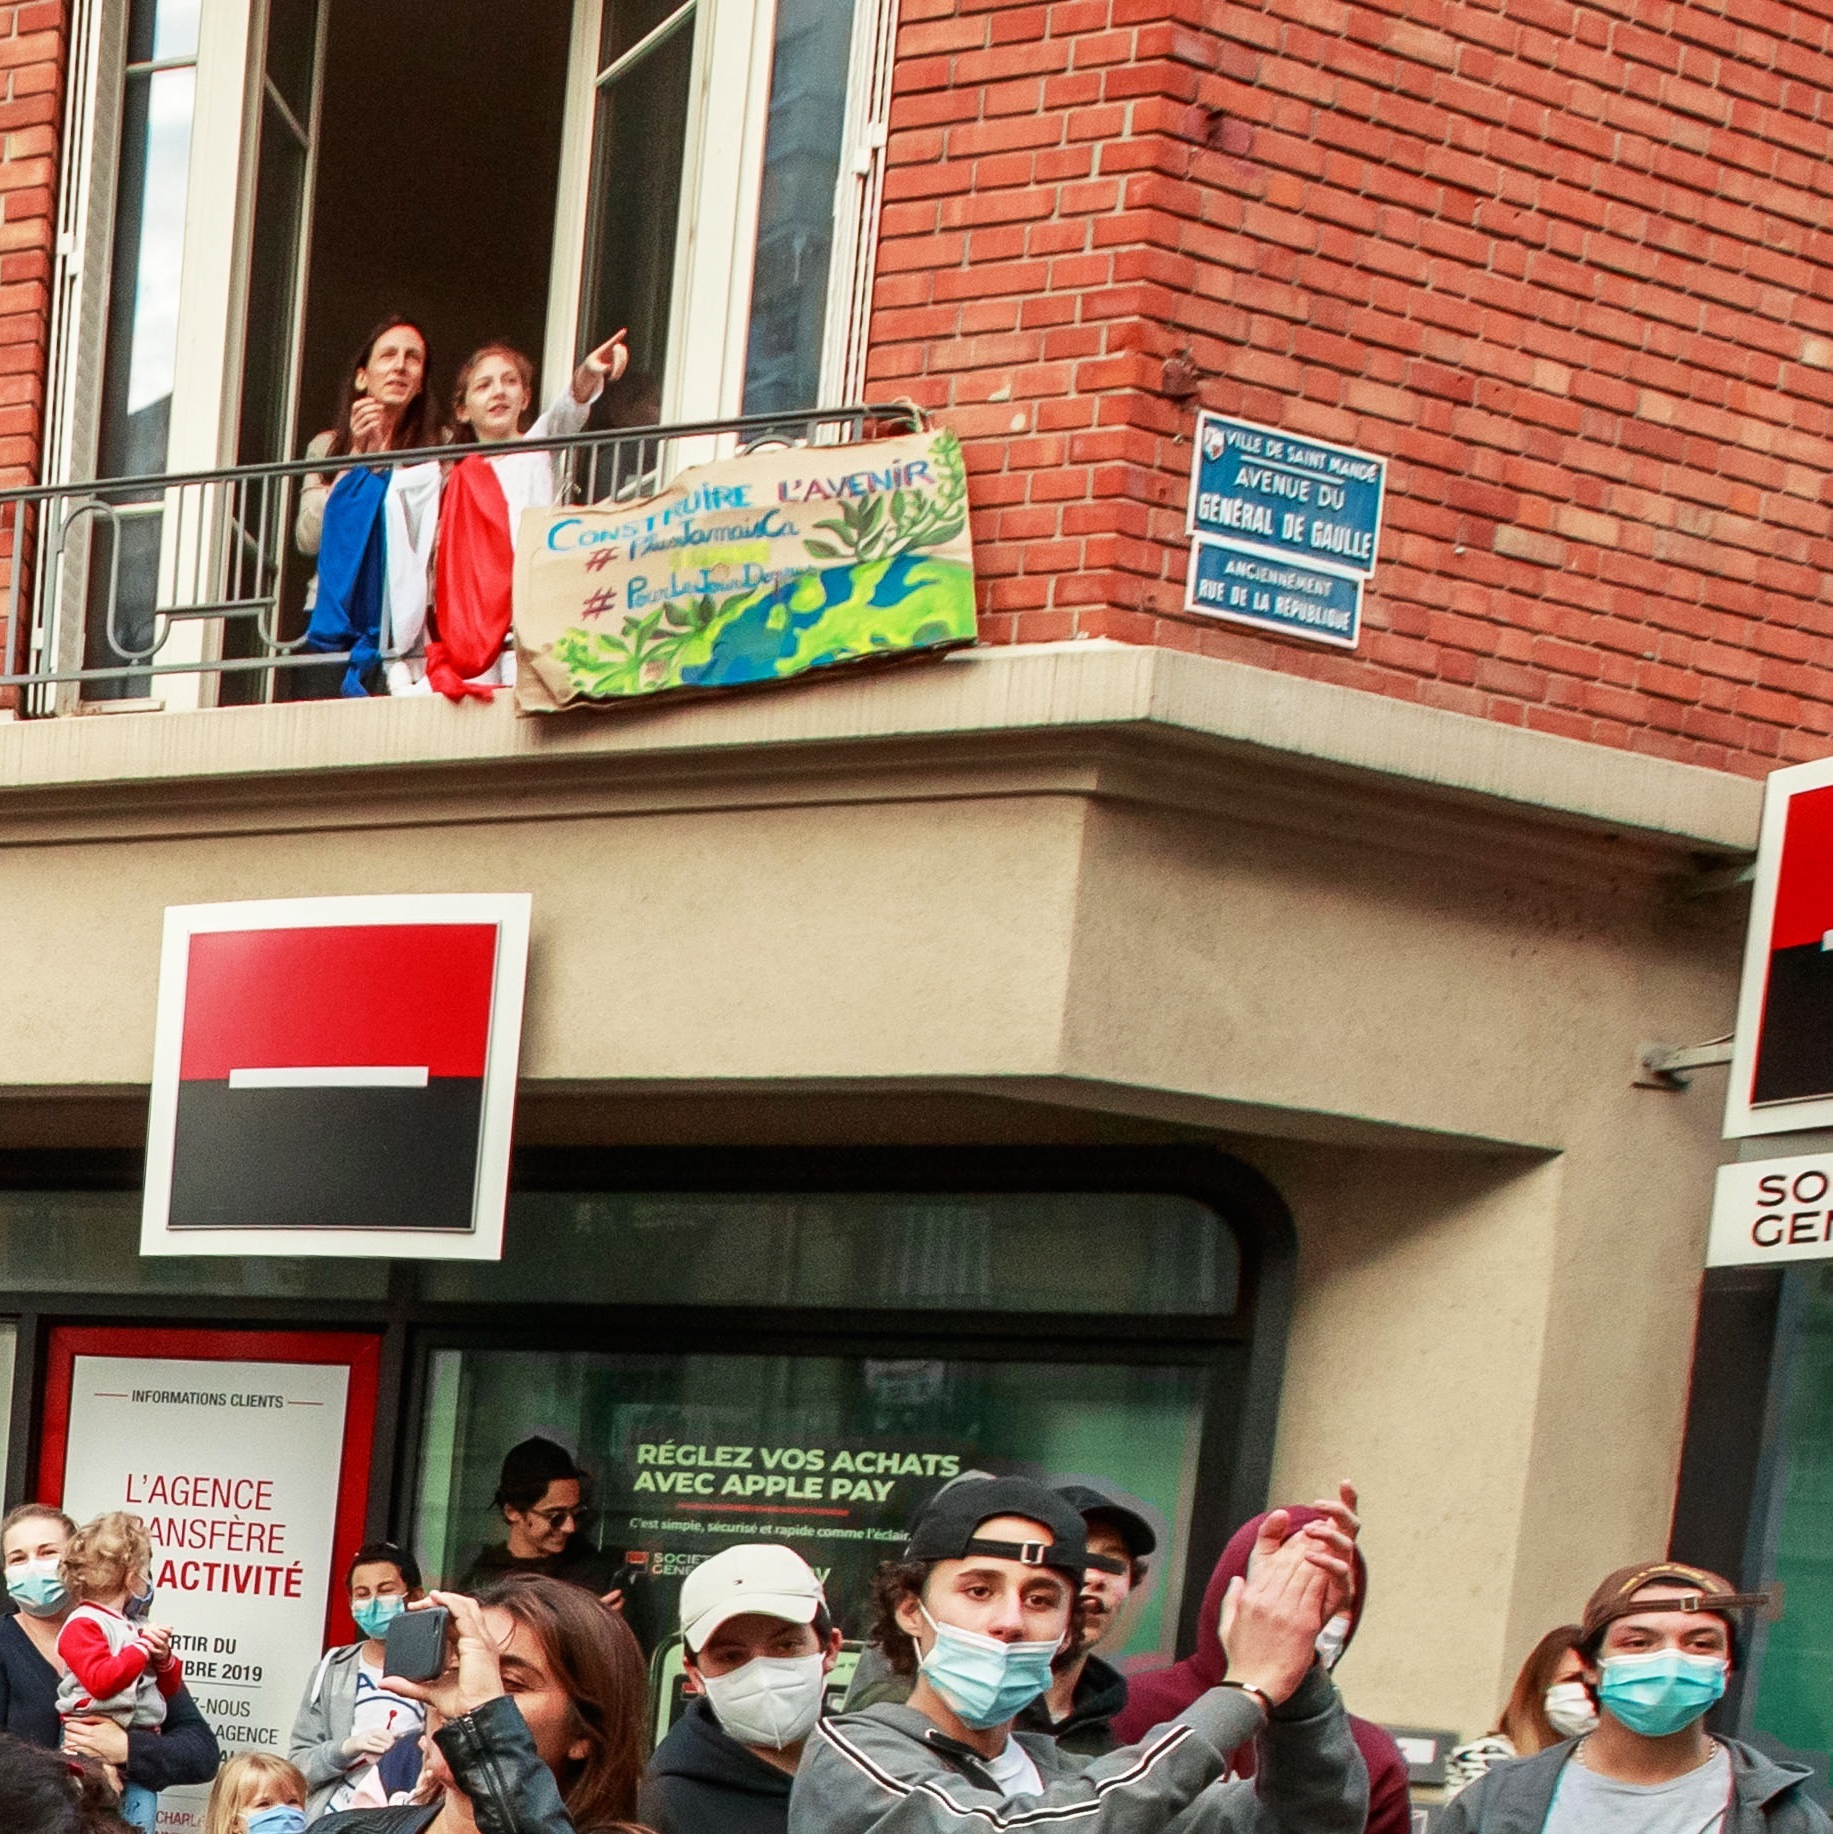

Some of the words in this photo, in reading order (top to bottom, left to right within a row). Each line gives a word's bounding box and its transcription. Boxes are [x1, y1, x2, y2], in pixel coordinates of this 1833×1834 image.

[1225, 430, 1263, 455] VILLE
[1265, 438, 1283, 459] DE
[1286, 444, 1327, 469] SAINT
[547, 482, 753, 552] CONSTRUIRE
[777, 458, 936, 503] L'AVENIR
[1233, 467, 1310, 503] AVENUE
[1317, 487, 1345, 511] DU
[1197, 492, 1274, 536] GÉNÉRAL
[1282, 512, 1305, 542] DE
[1310, 520, 1373, 560] GAULLE
[1198, 578, 1225, 602] RUE
[1230, 586, 1248, 607] DE
[1252, 591, 1270, 612] LA
[132, 1389, 227, 1407] INFORMATIONS
[230, 1393, 284, 1408] CLIENTS
[636, 1439, 754, 1469] RÉGLEZ
[760, 1448, 825, 1472] VOS
[831, 1450, 960, 1478] ACHATS
[125, 1474, 274, 1511] L'AGENCE
[633, 1471, 715, 1495] AVEC
[721, 1474, 825, 1499] APPLE
[831, 1477, 896, 1502] PAY
[133, 1514, 286, 1555] ANSFÈRE
[759, 1524, 773, 1535] et
[775, 1524, 815, 1539] rapide
[817, 1527, 863, 1538] comme
[156, 1559, 304, 1598] ACTIVITÉ
[214, 1637, 237, 1655] DU
[222, 1663, 263, 1682] 2019
